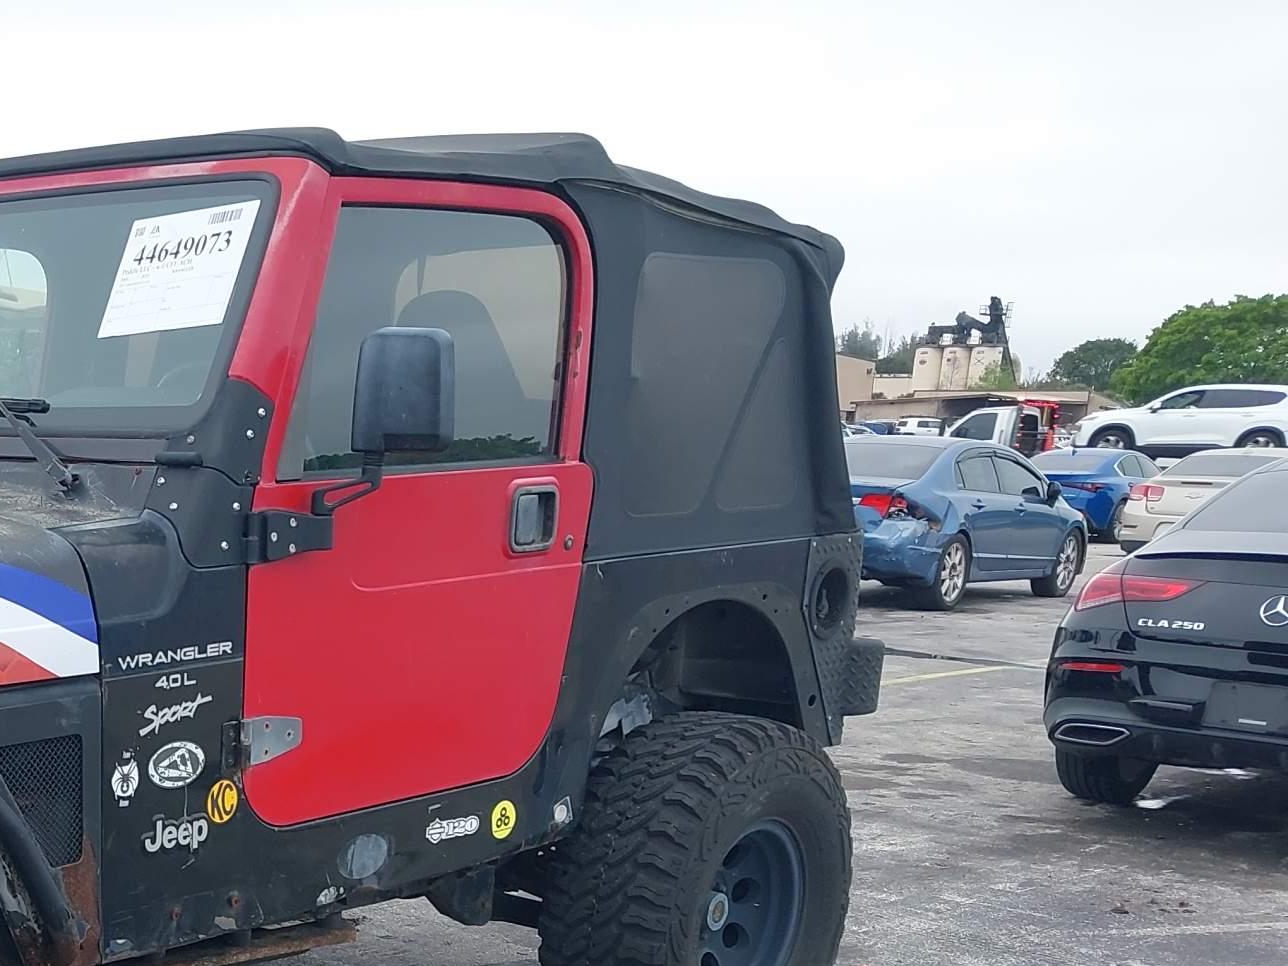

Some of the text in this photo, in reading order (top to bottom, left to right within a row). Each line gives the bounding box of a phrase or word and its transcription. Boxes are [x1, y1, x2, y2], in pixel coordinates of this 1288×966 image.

[133, 229, 233, 266] 44649073
[1138, 619, 1205, 630] CLA 250
[117, 641, 233, 670] WRANGLER
[210, 781, 235, 822] KC
[144, 816, 209, 854] Jeep
[447, 816, 479, 836] 120
